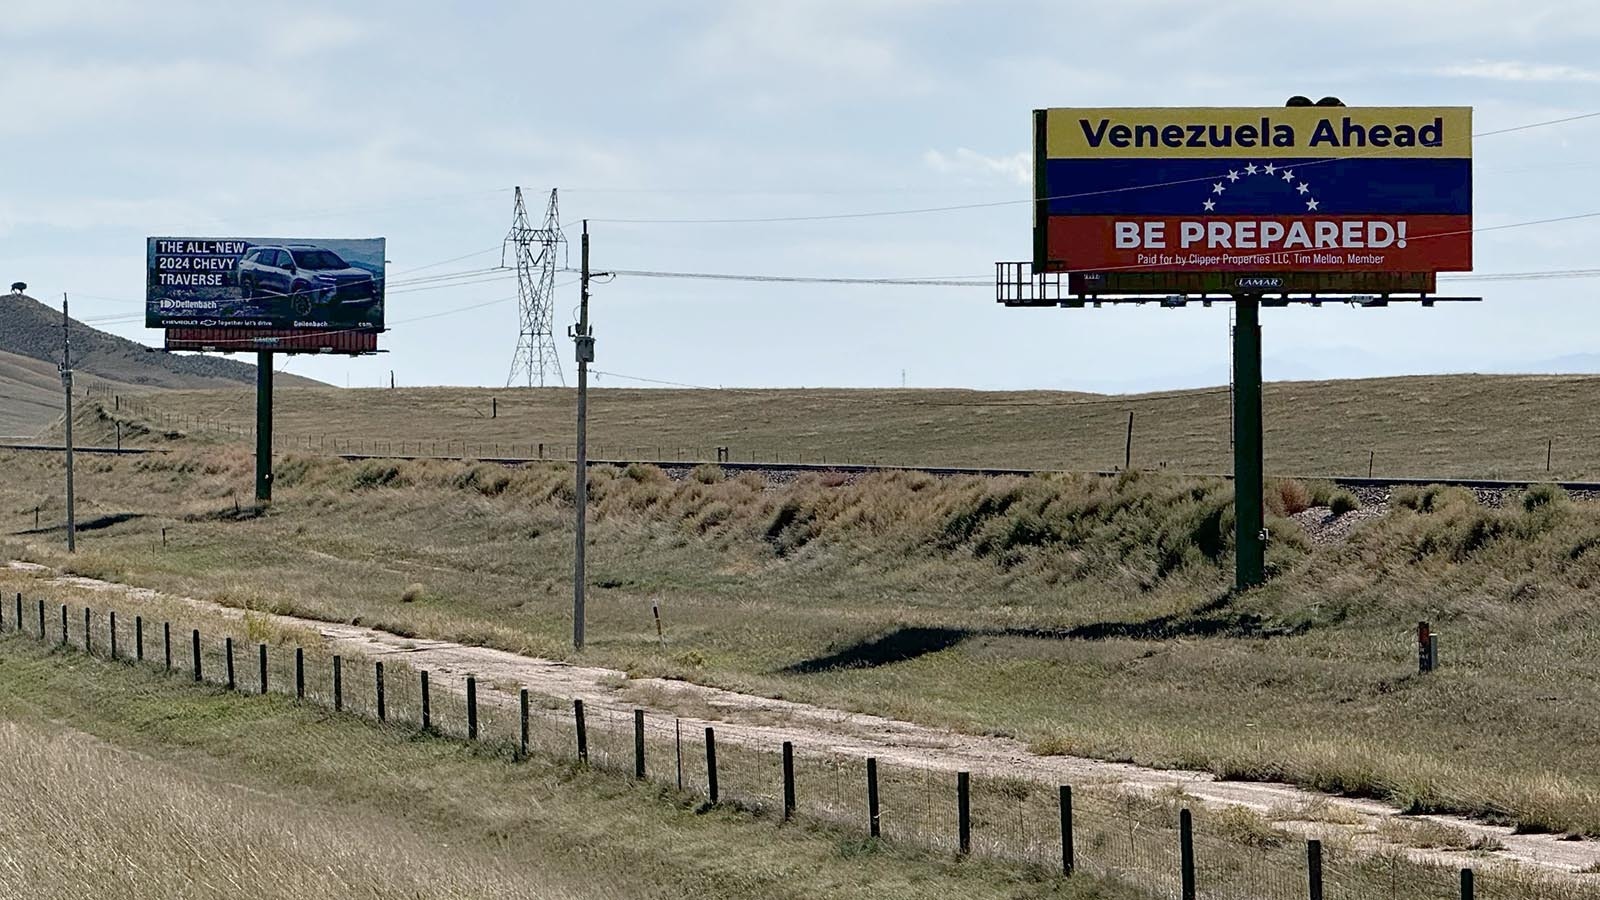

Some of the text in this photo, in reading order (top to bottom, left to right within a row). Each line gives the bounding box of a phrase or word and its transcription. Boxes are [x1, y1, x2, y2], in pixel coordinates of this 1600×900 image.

[1079, 118, 1443, 148] Venezuela Ahead
[1115, 221, 1407, 249] BE PREPARED!
[160, 242, 245, 253] THE ALL-NEW
[160, 258, 235, 269] 2024 CHEVY
[1137, 254, 1385, 266] Paid for by Clipper Properties LLC, Tim Mellon, Member
[159, 274, 223, 285] TRAVERSE
[176, 300, 217, 309] Dellenbach
